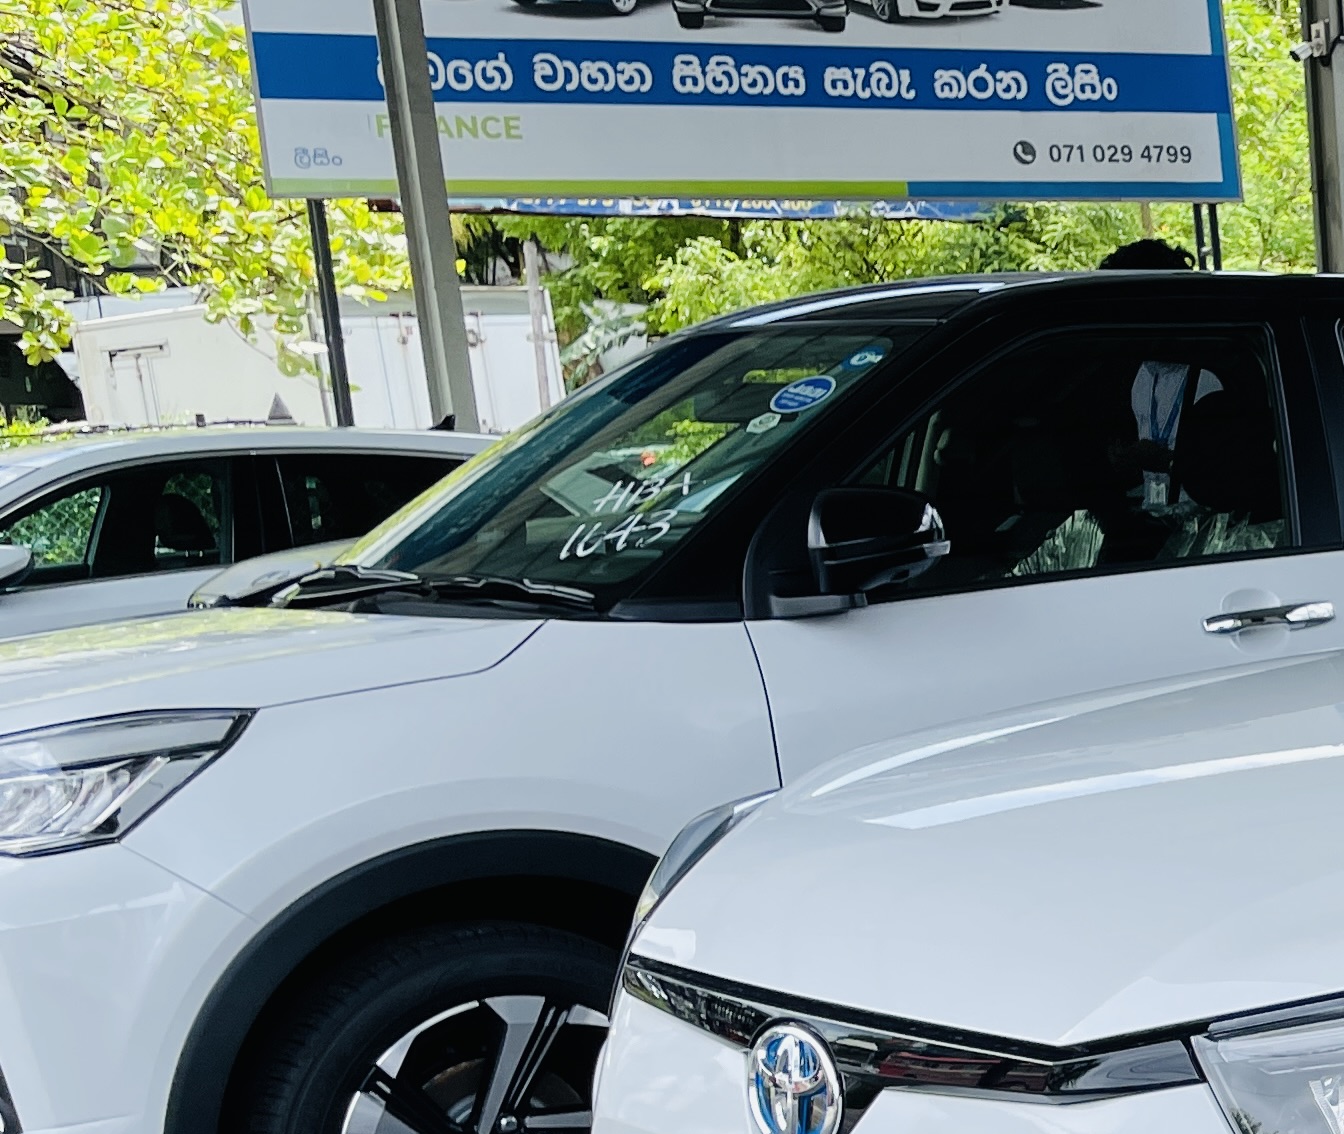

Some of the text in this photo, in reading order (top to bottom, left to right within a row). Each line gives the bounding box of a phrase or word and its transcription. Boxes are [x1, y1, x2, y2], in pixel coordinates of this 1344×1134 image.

[533, 52, 653, 92] වාහන
[672, 54, 806, 95] සිහිනය
[934, 63, 1028, 99] කරන
[375, 114, 523, 140] FANCE
[1049, 144, 1192, 164] 071 029 4799
